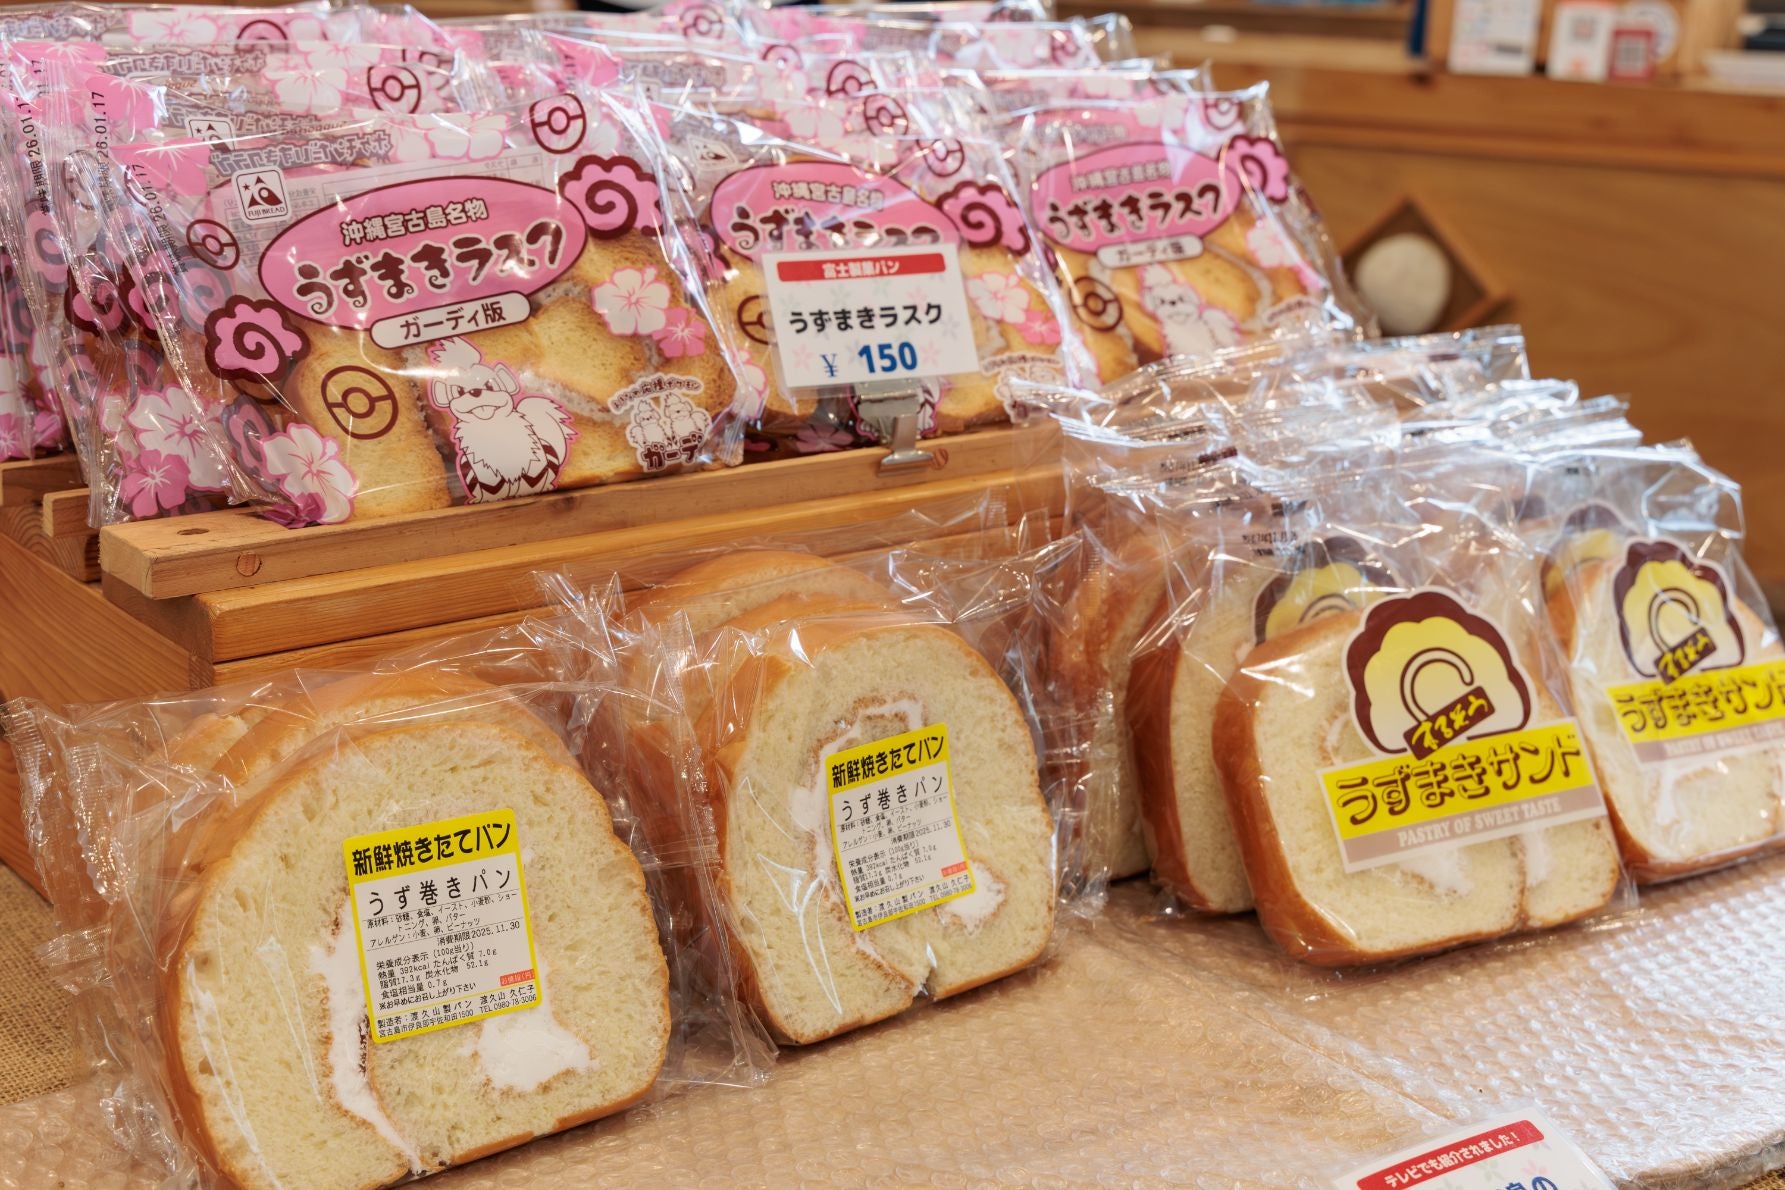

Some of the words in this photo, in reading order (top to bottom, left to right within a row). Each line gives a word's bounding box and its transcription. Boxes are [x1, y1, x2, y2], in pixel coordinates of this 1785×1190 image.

[91, 91, 109, 158] 26.01.17
[131, 163, 165, 222] 26.01.17
[1048, 182, 1221, 240] うずまきラスク
[341, 198, 488, 246] 沖縄宮古島名物
[296, 221, 564, 315] うずまきラスク
[400, 301, 506, 340] ガーディ版
[789, 302, 943, 334] うずまきラスク
[820, 353, 838, 378] ¥
[858, 341, 918, 374] 150
[832, 736, 944, 788] 新鮮焼きたてパン
[1336, 733, 1581, 826] うずまきサンド
[841, 776, 943, 822] うず巻きパン
[1397, 821, 1451, 847] PASTRY
[1454, 816, 1473, 834] OF
[1474, 806, 1520, 829] SWEET
[1521, 797, 1562, 818] TASTE
[352, 823, 511, 876] 新鮮焼きたてパン
[369, 869, 510, 916] うず巻きパン
[436, 920, 520, 946] 消費期限2025.11.30
[375, 950, 429, 970] 栄養成分表示
[432, 951, 475, 968] たんぱく質
[479, 1003, 493, 1013] TEL
[509, 983, 534, 998] 久仁子
[1384, 1131, 1521, 1189] テレビでも紹介されました！
